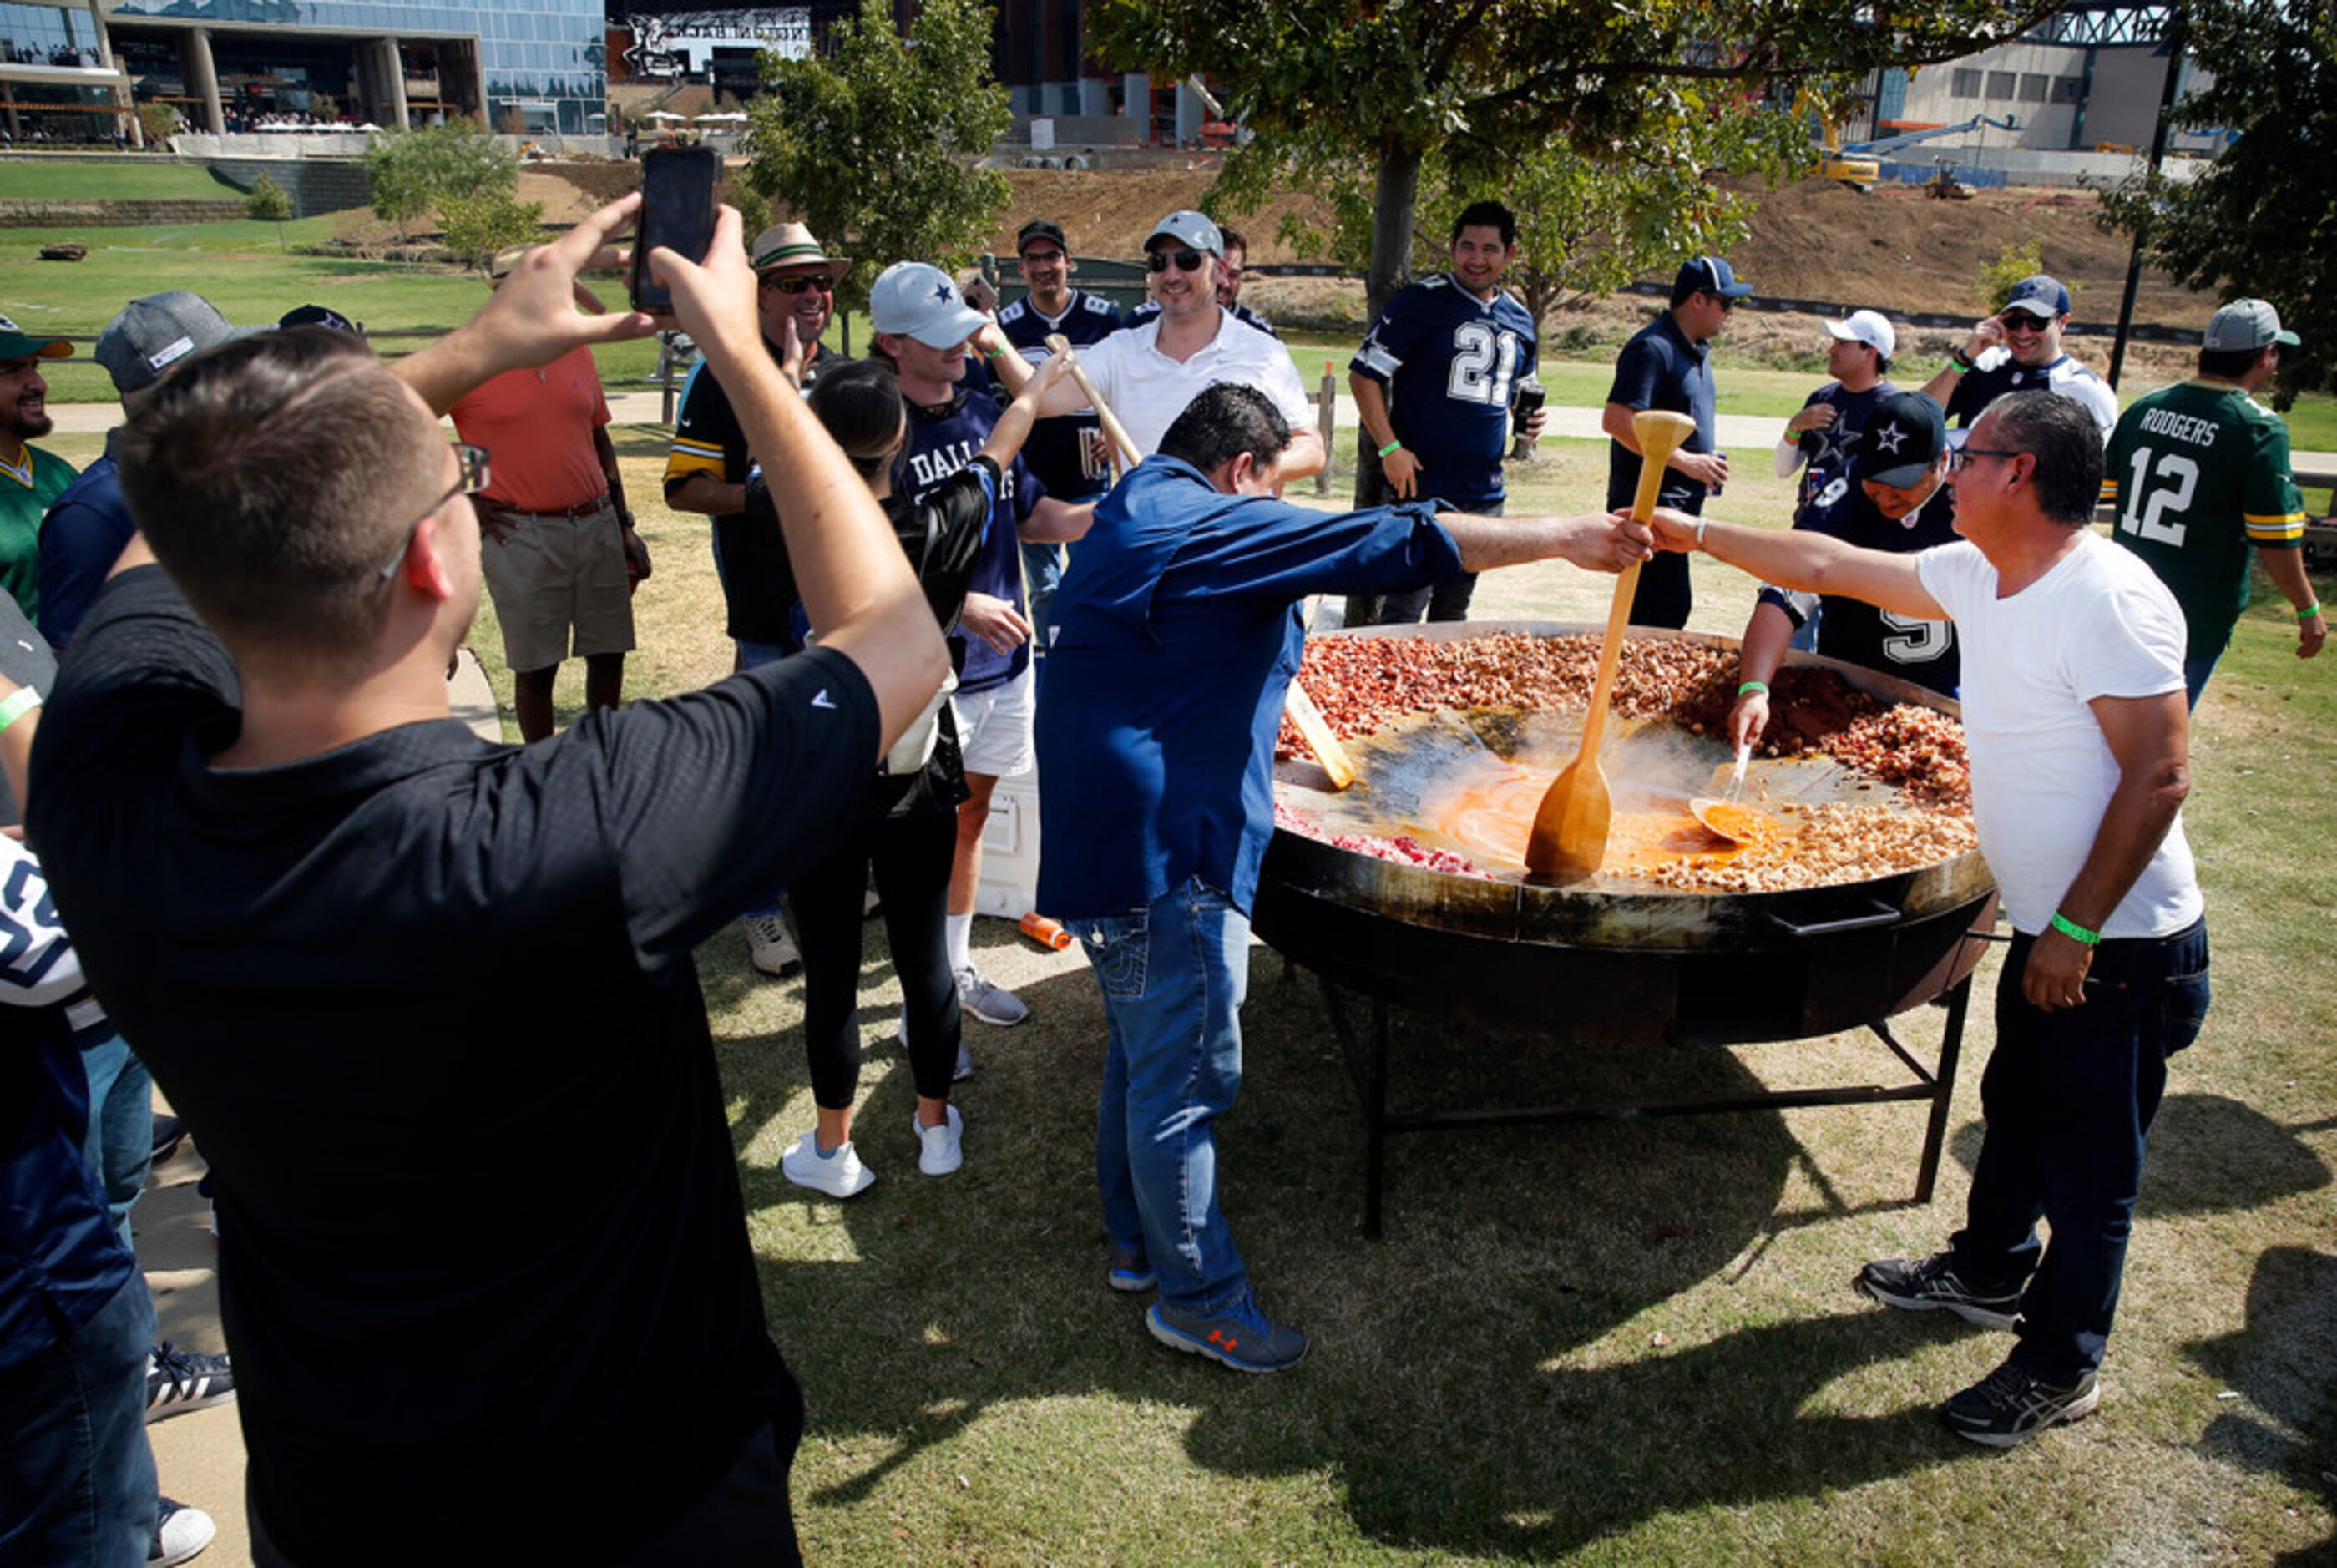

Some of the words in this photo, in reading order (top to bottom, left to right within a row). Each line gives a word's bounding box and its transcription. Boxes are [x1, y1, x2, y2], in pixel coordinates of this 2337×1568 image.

[1446, 320, 1517, 407] 21
[2139, 407, 2219, 447] RODGERS
[1813, 476, 1849, 508] 9
[2120, 446, 2200, 548] 12
